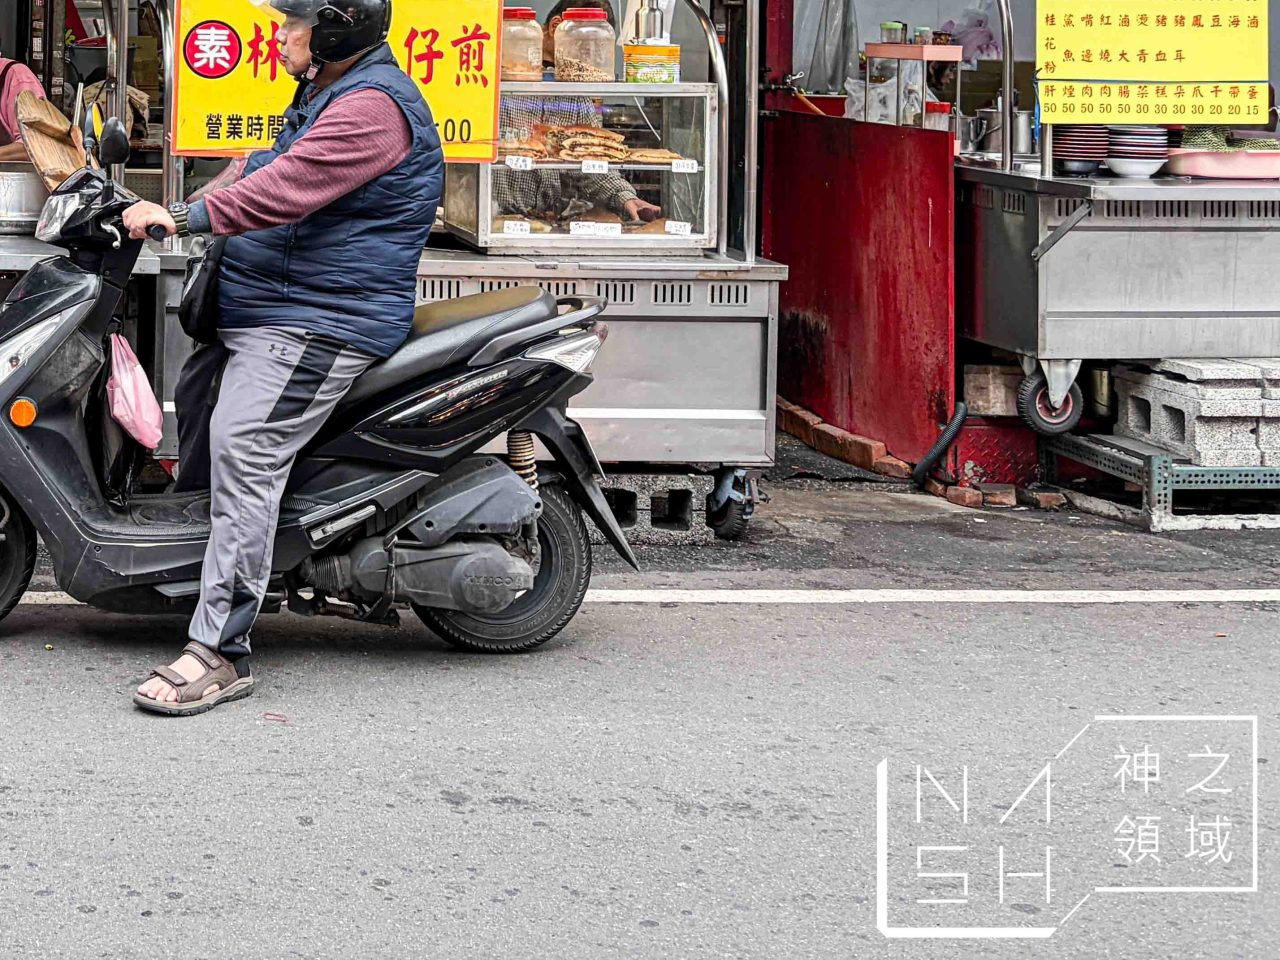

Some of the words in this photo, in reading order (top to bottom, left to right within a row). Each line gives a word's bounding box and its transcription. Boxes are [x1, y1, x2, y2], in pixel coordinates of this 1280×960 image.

[194, 26, 231, 69] 素
[1043, 102, 1057, 113] 50
[1062, 103, 1075, 113] 50
[1080, 103, 1094, 113] 50
[1099, 103, 1112, 113] 50
[1117, 103, 1131, 114] 50
[1136, 103, 1149, 114] 30
[1154, 104, 1168, 114] 30
[1172, 104, 1186, 114] 30
[1191, 104, 1205, 115] 30
[1209, 104, 1223, 115] 20
[1227, 105, 1241, 115] 20
[1246, 105, 1259, 115] 15
[206, 113, 286, 141] 營業時間
